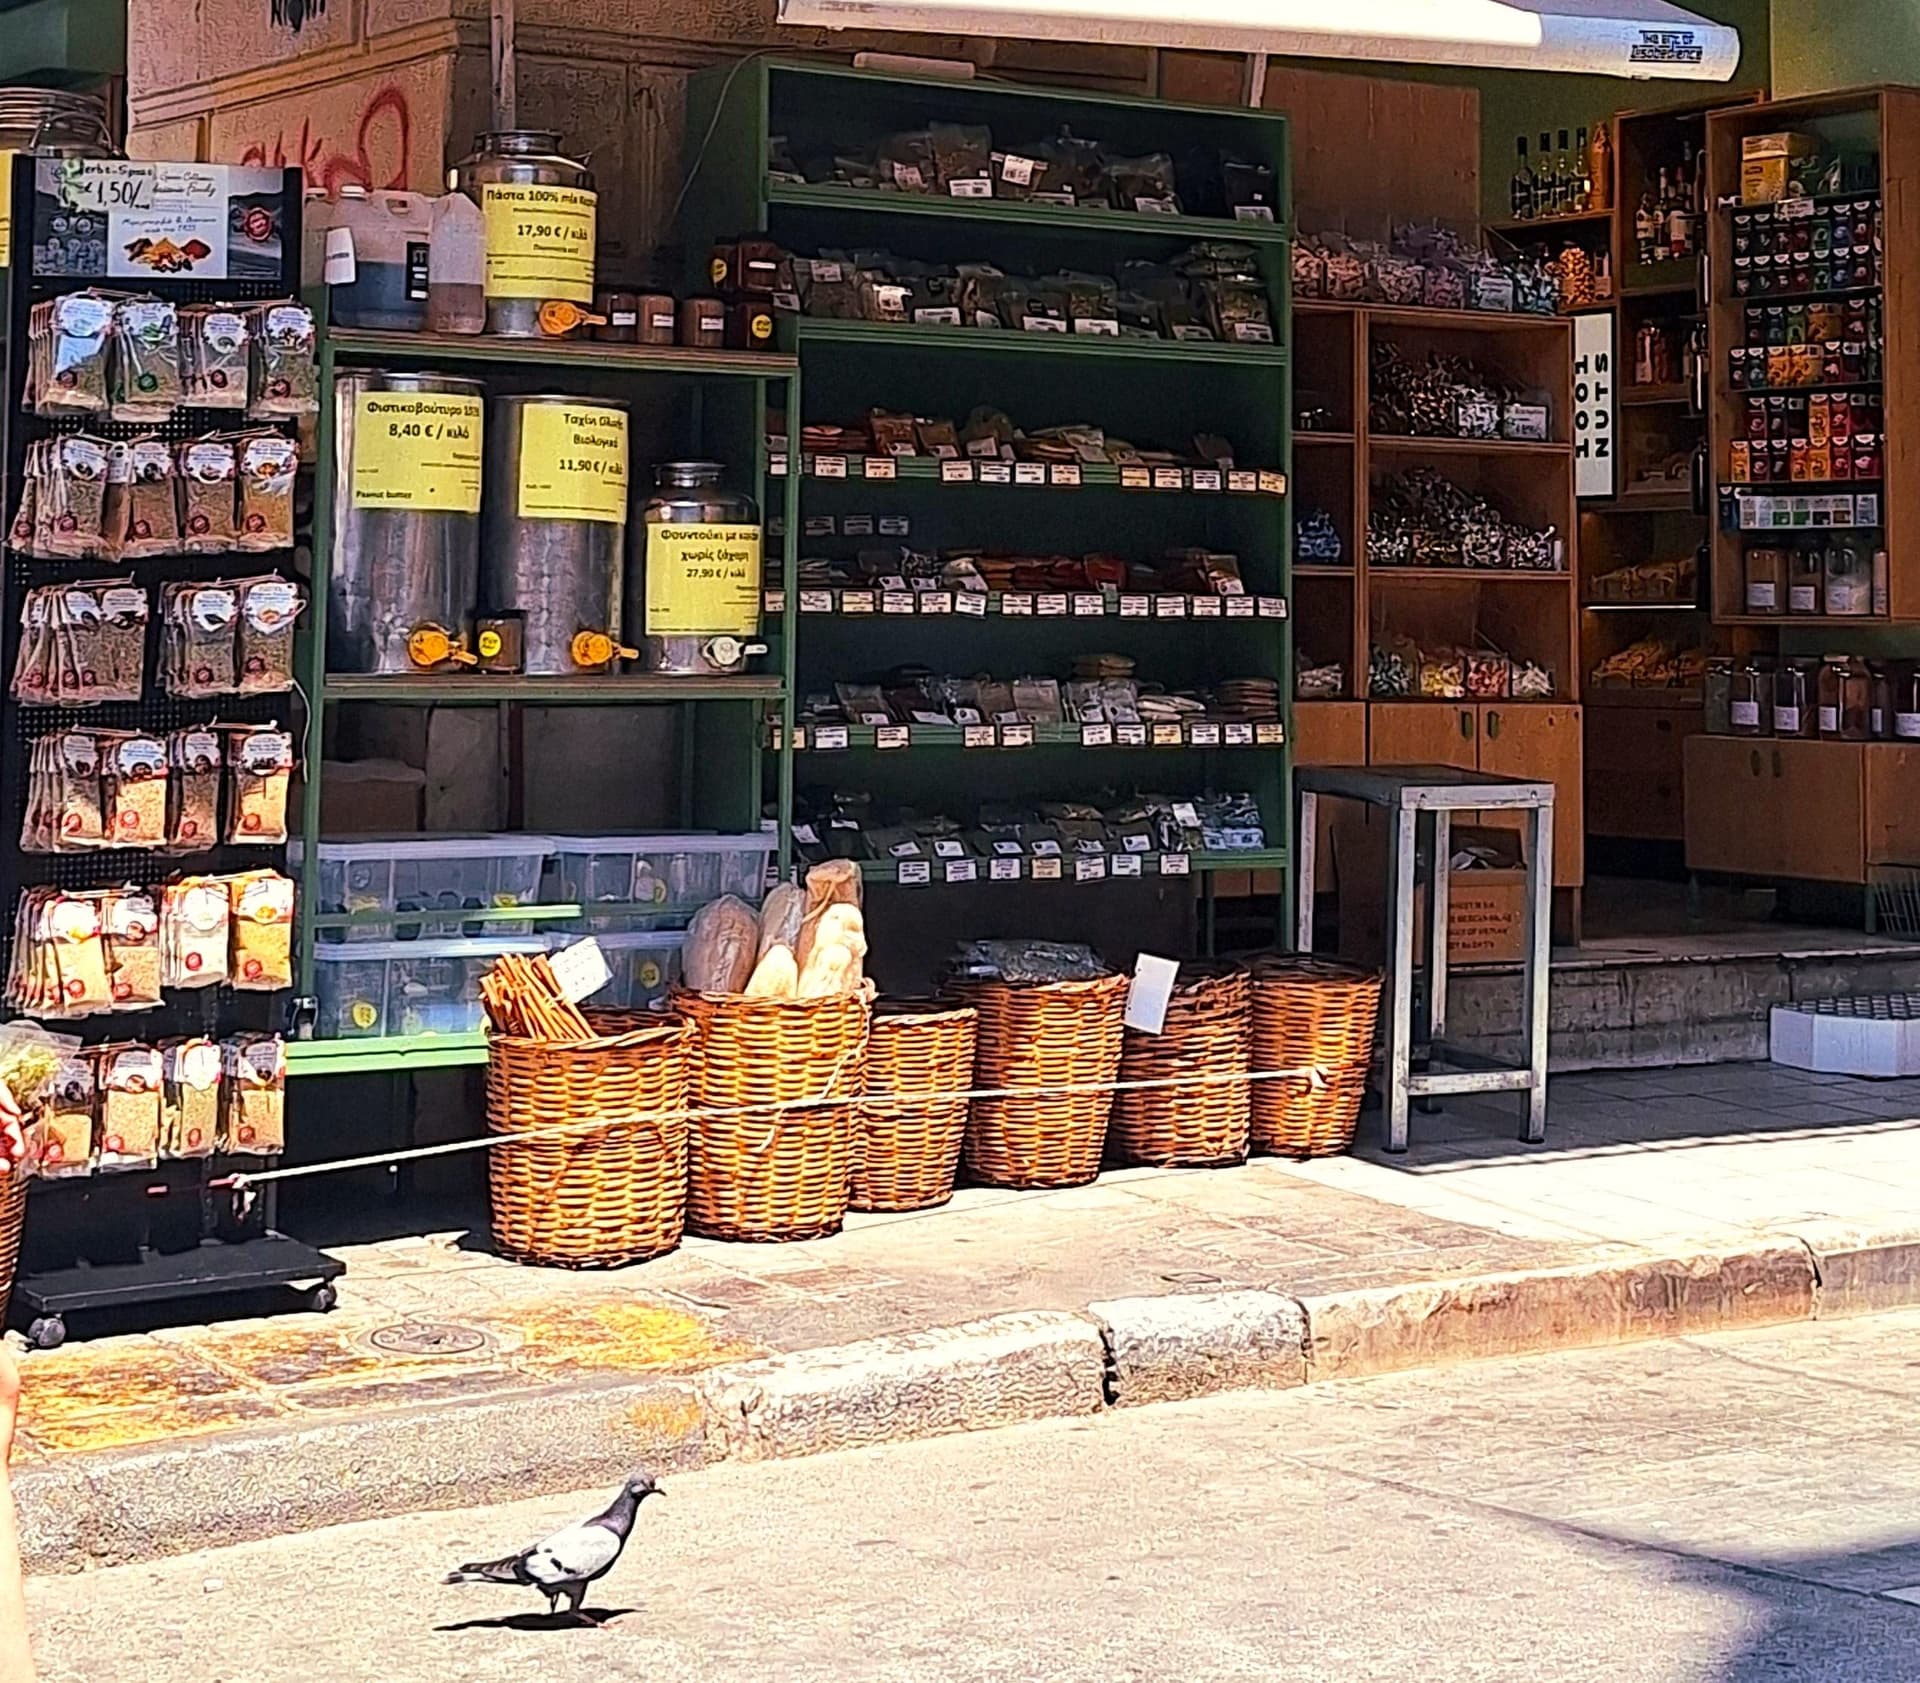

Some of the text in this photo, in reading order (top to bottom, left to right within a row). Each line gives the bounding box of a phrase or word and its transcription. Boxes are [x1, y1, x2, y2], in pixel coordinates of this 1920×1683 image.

[487, 190, 525, 201] Πάστα
[529, 191, 558, 202] 100%
[518, 225, 551, 237] 17,90
[367, 402, 462, 417] Φιστικοβούτυρο
[1595, 353, 1609, 458] NUTS
[563, 413, 597, 427] Ταχίνι
[389, 424, 420, 438] 8,40
[446, 425, 469, 439] κιλό
[356, 490, 384, 499] Peanut
[661, 529, 723, 541] Φουντούκι
[681, 548, 714, 562] χωρίς
